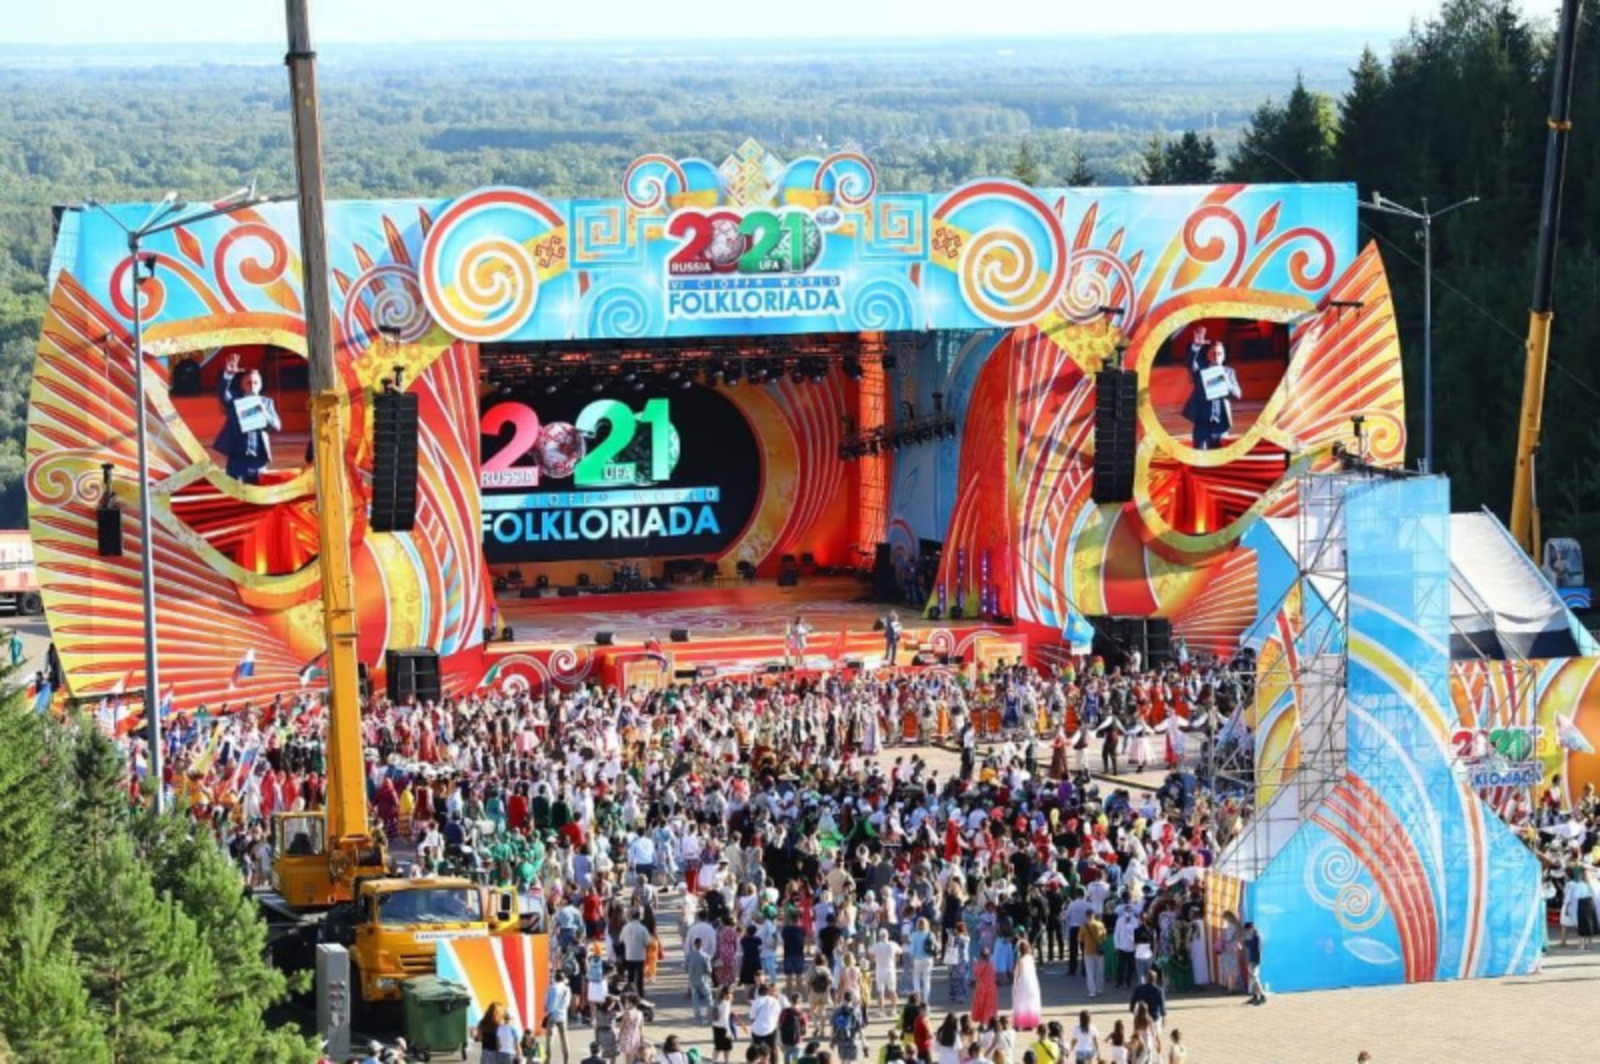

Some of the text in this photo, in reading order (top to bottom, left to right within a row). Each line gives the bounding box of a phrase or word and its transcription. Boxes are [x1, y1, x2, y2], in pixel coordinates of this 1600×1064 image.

[669, 211, 822, 275] 2021
[671, 262, 711, 272] RUSSIA
[759, 261, 780, 270] UFA
[669, 290, 841, 314] FOLKLORIADA
[481, 398, 680, 487] 2021
[482, 505, 720, 543] FOLKLORIADA
